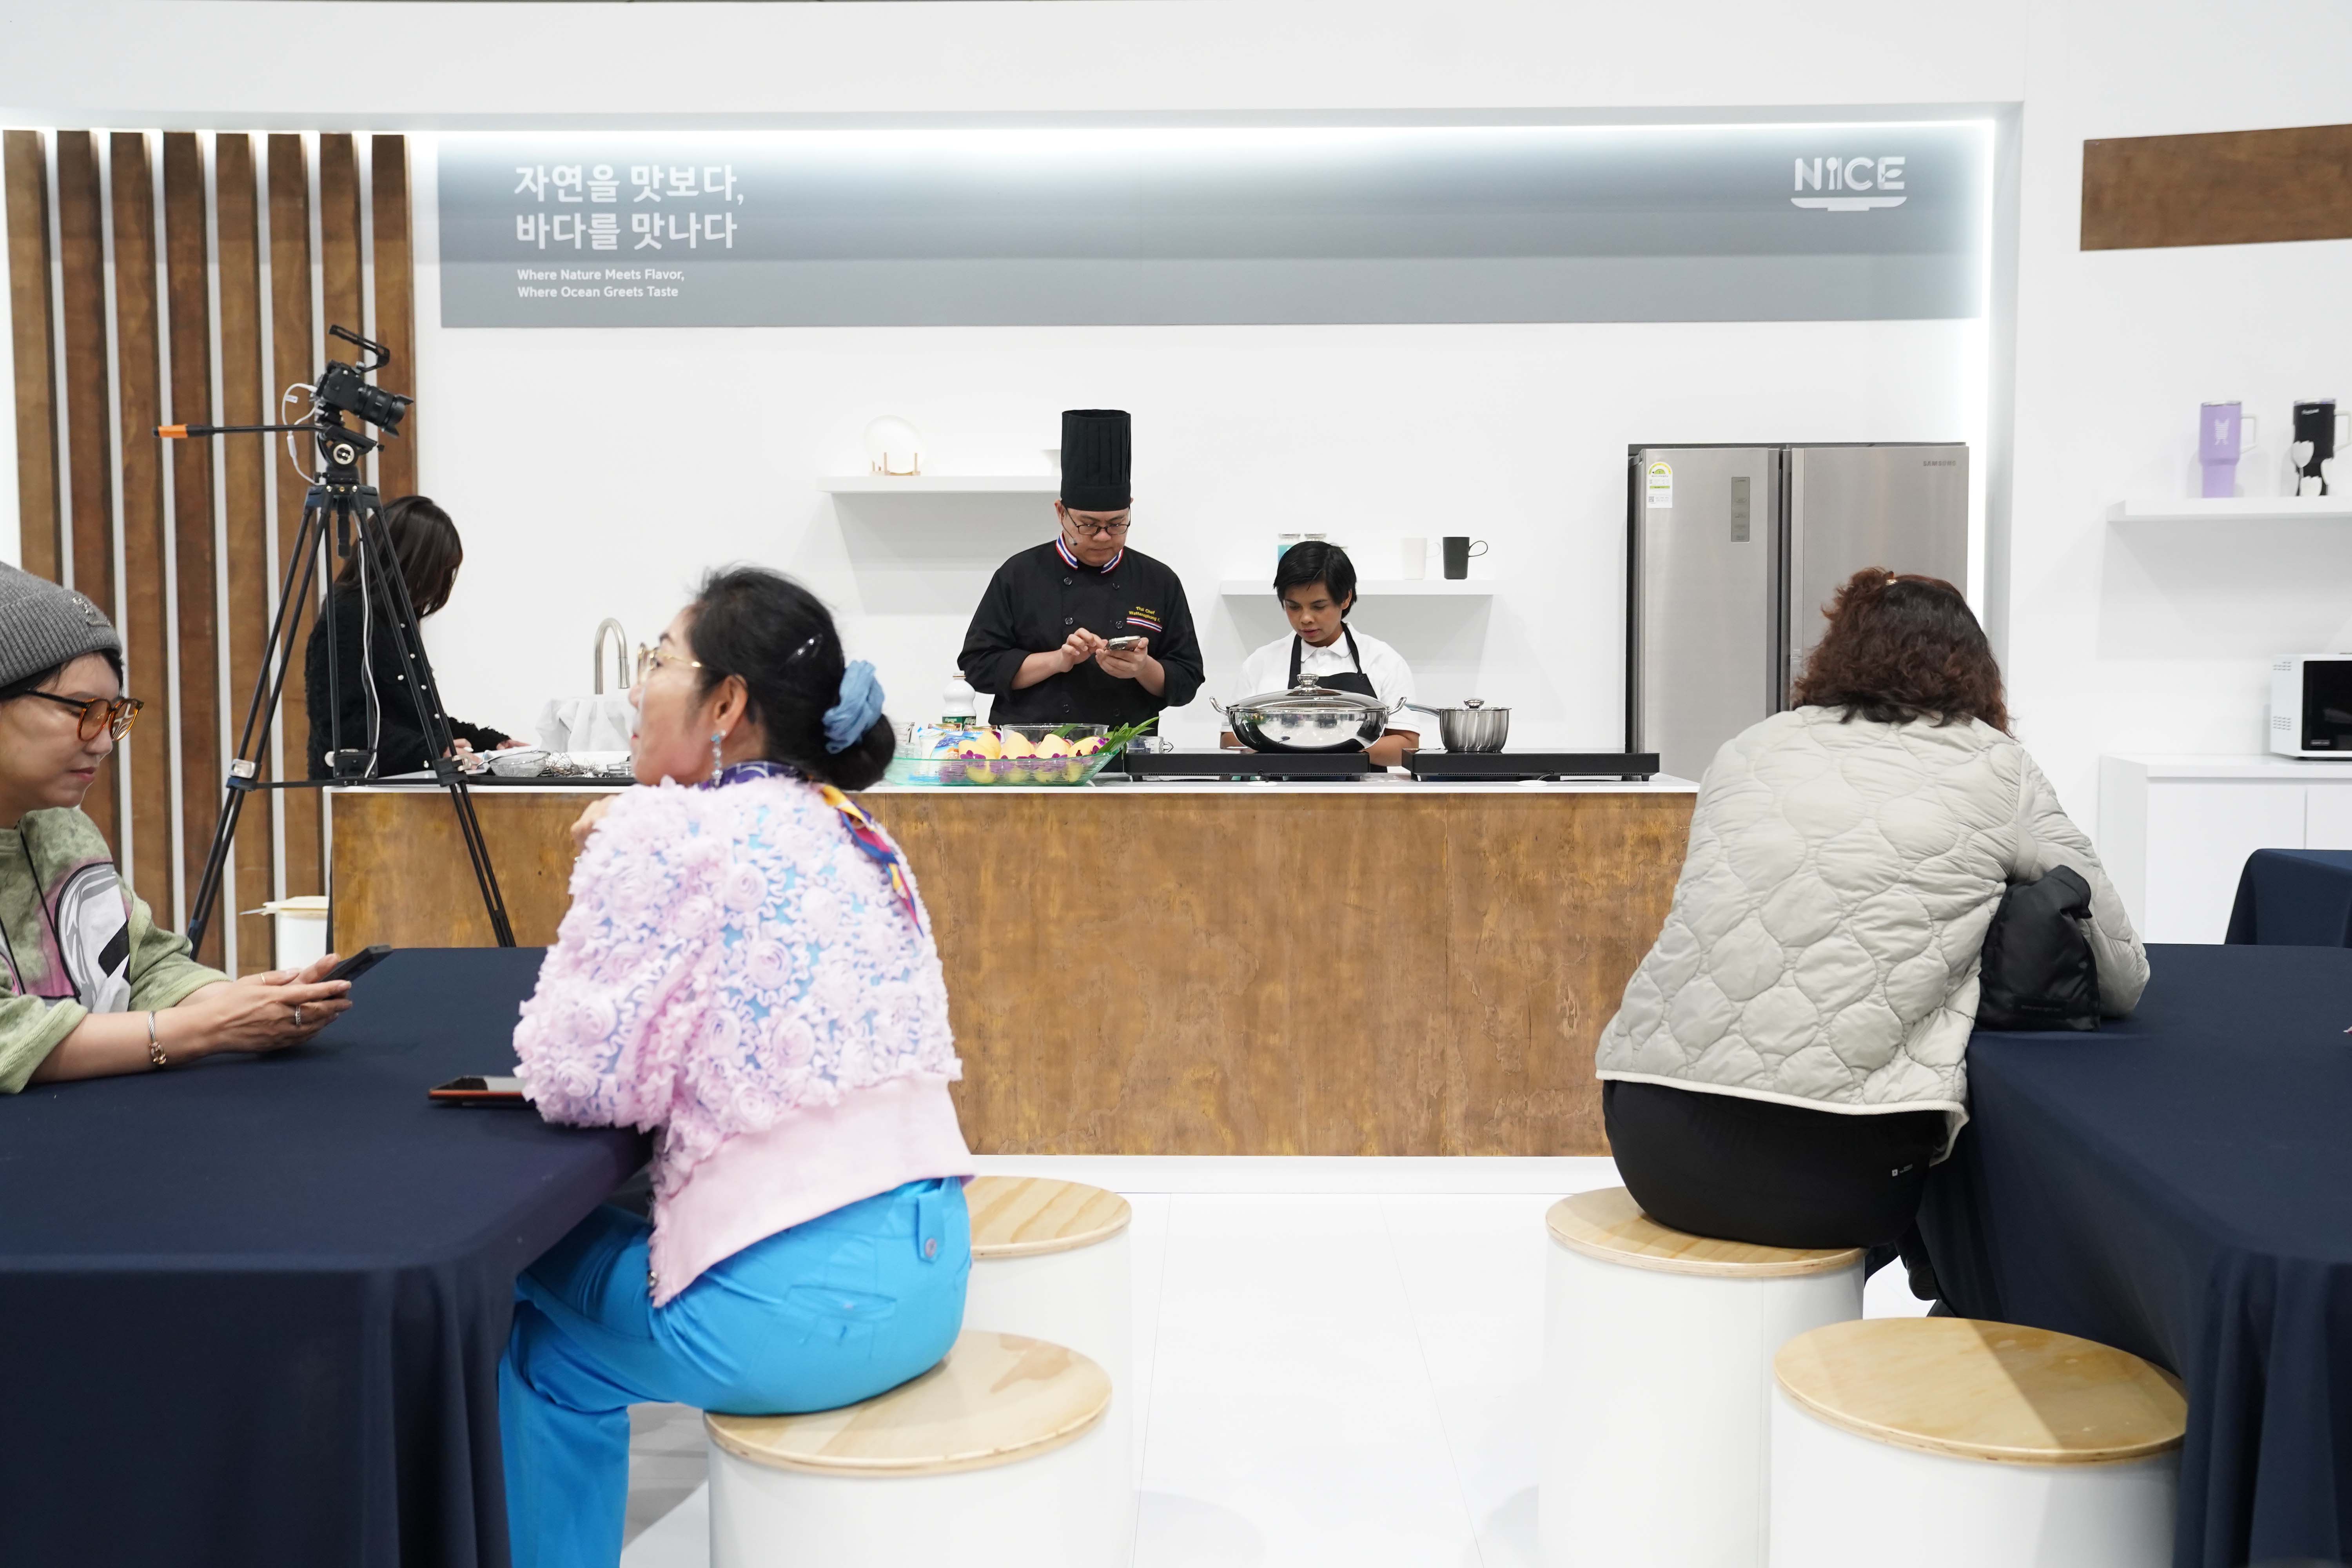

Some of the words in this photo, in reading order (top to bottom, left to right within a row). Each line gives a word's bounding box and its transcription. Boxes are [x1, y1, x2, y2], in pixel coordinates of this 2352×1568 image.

[514, 164, 620, 203] 자연을
[630, 164, 744, 205] 맛보다,
[1794, 156, 1906, 191] NICE
[516, 212, 621, 250] 바다를
[631, 212, 738, 250] 맛나다
[517, 269, 557, 281] Where
[561, 269, 602, 280] Nature
[605, 269, 641, 280] Meets
[644, 268, 685, 282] Flavor,
[517, 286, 558, 298] Where
[561, 286, 601, 298] Ocean
[603, 286, 644, 298] Greets
[647, 285, 679, 297] Taste
